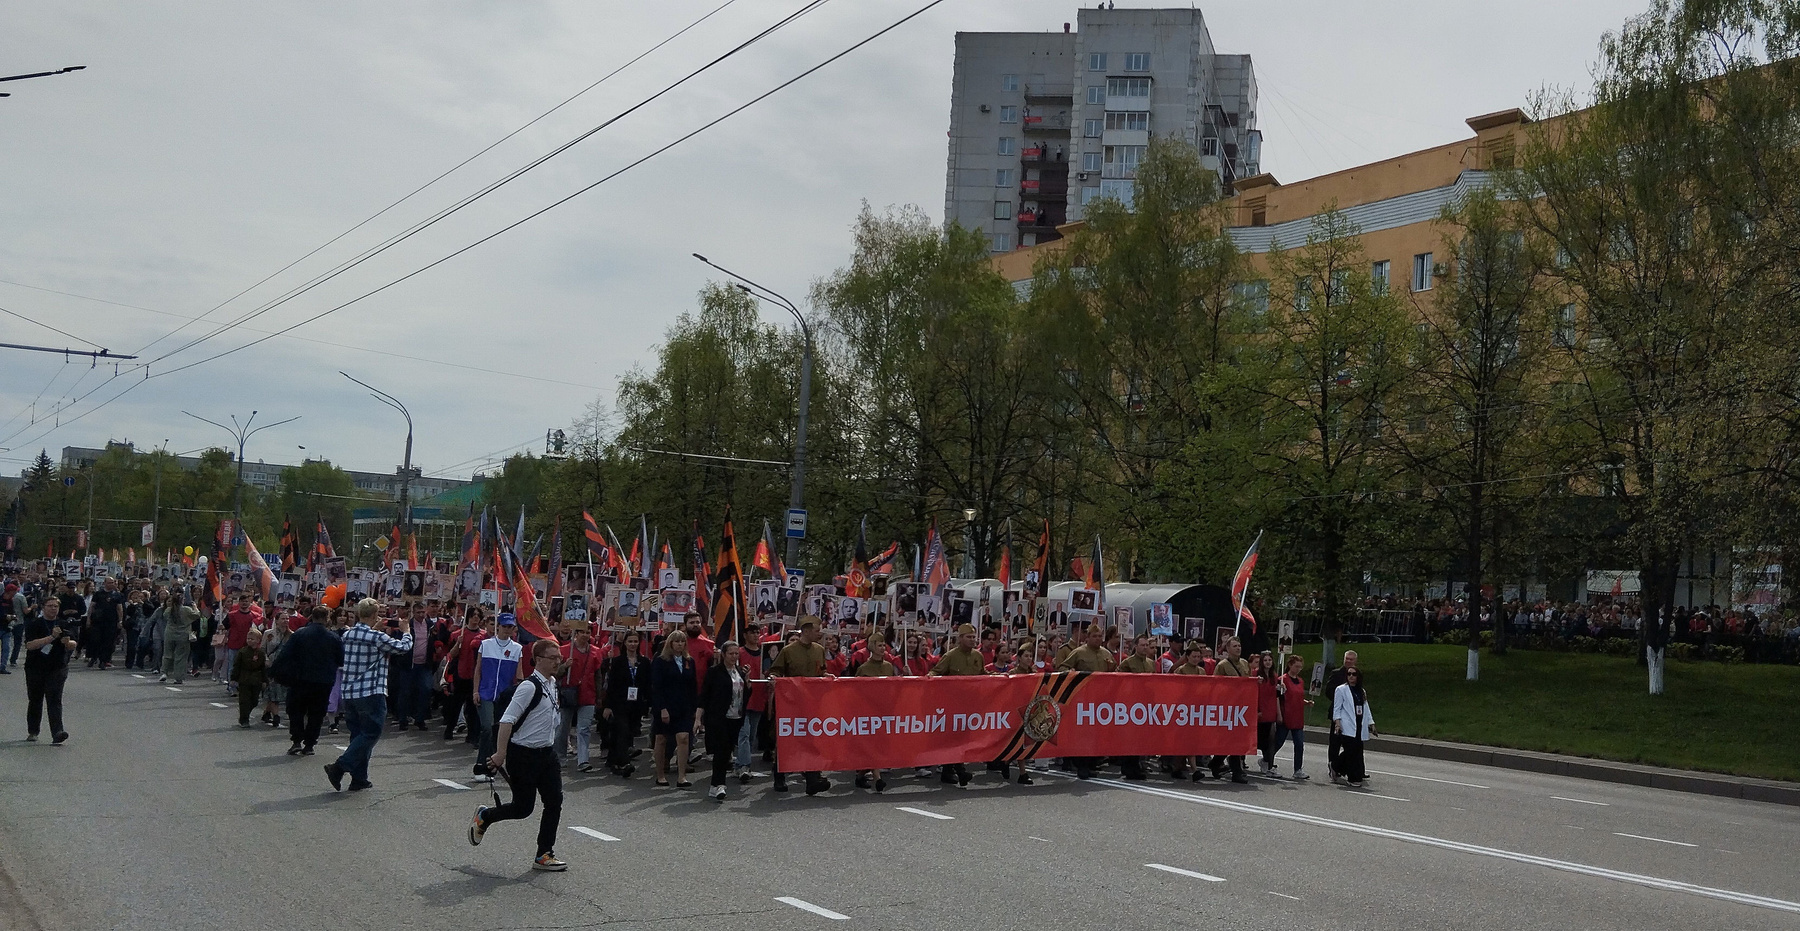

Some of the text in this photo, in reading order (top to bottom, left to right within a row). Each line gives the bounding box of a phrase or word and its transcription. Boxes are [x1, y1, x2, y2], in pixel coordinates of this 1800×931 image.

[67, 565, 80, 574] Z
[95, 568, 107, 577] Z
[778, 708, 1011, 737] БЕССМЕРТНЫЙ ПОЛК
[1076, 702, 1249, 731] НОВОКУЗНЕЦК
